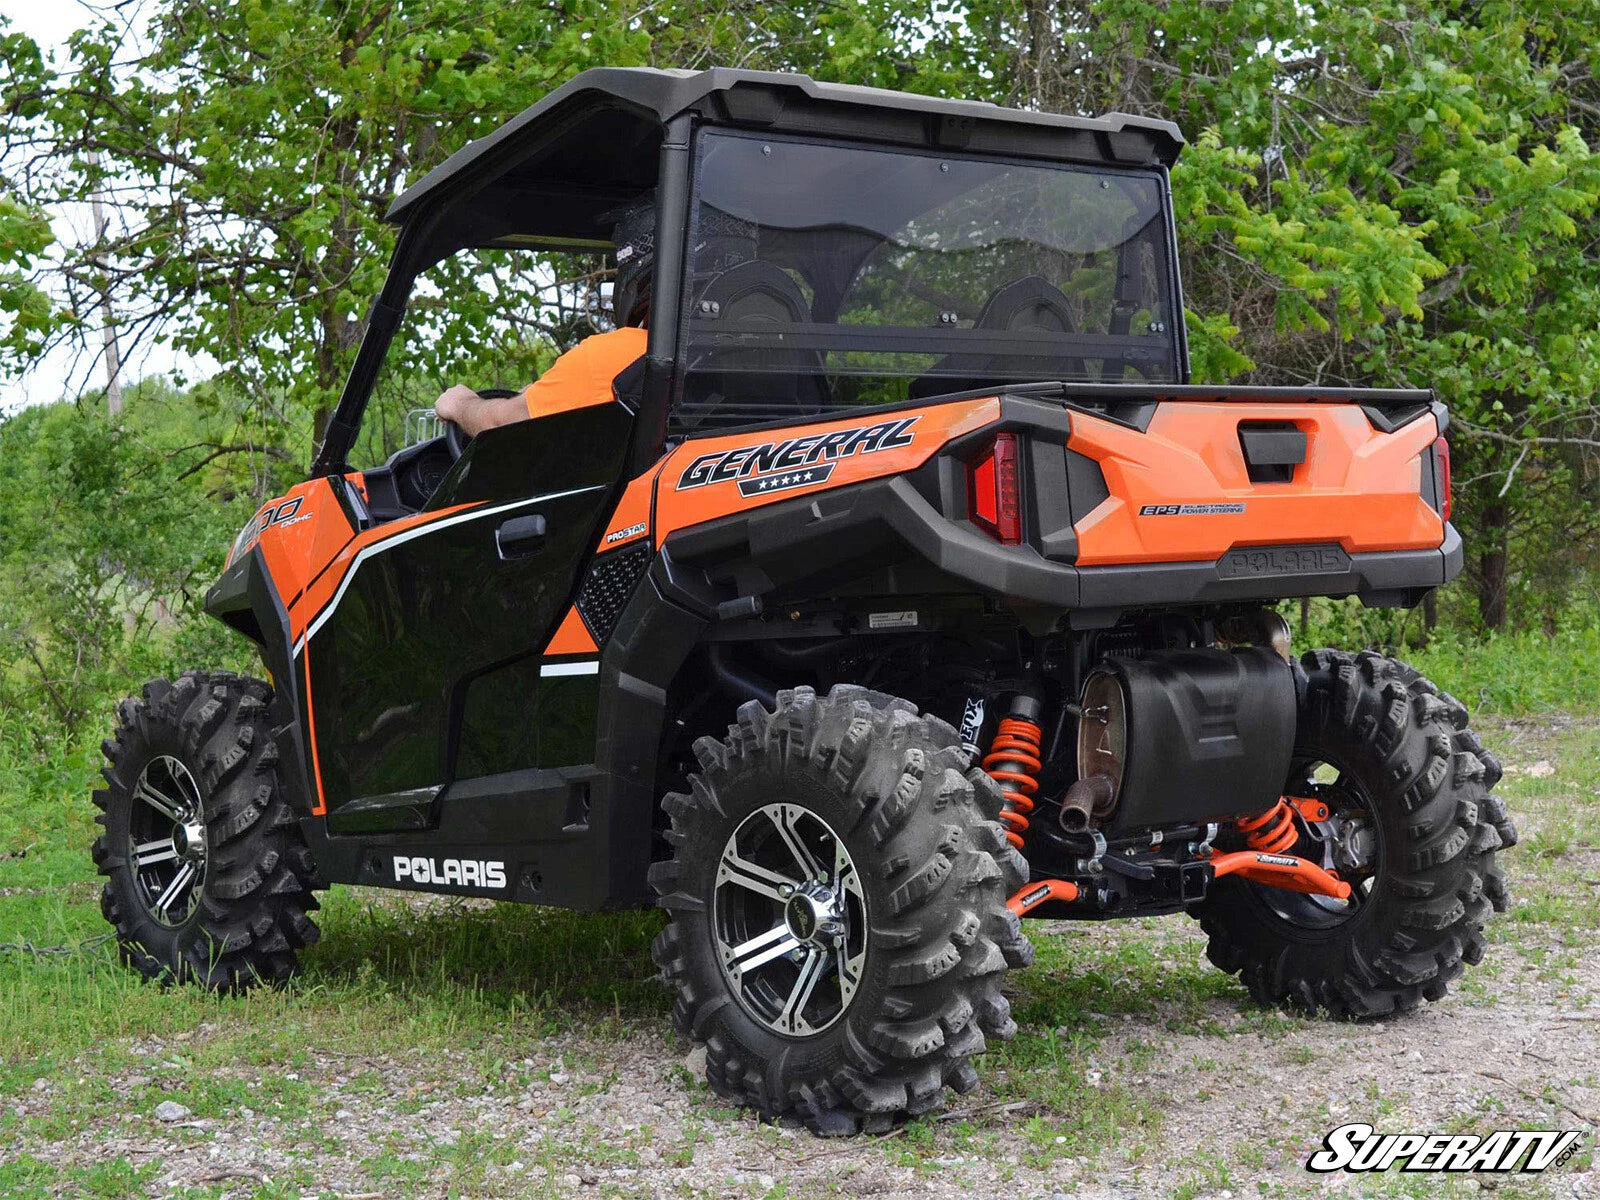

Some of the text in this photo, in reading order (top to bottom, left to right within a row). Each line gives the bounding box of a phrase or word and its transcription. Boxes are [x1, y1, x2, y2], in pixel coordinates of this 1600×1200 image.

[675, 415, 923, 491] GENERAL
[280, 511, 314, 529] DOHC
[1142, 504, 1179, 516] EPS
[606, 521, 646, 543] PROSTAR
[1230, 549, 1340, 574] POLARIS
[959, 697, 984, 741] FOX
[393, 856, 507, 888] POLARIS
